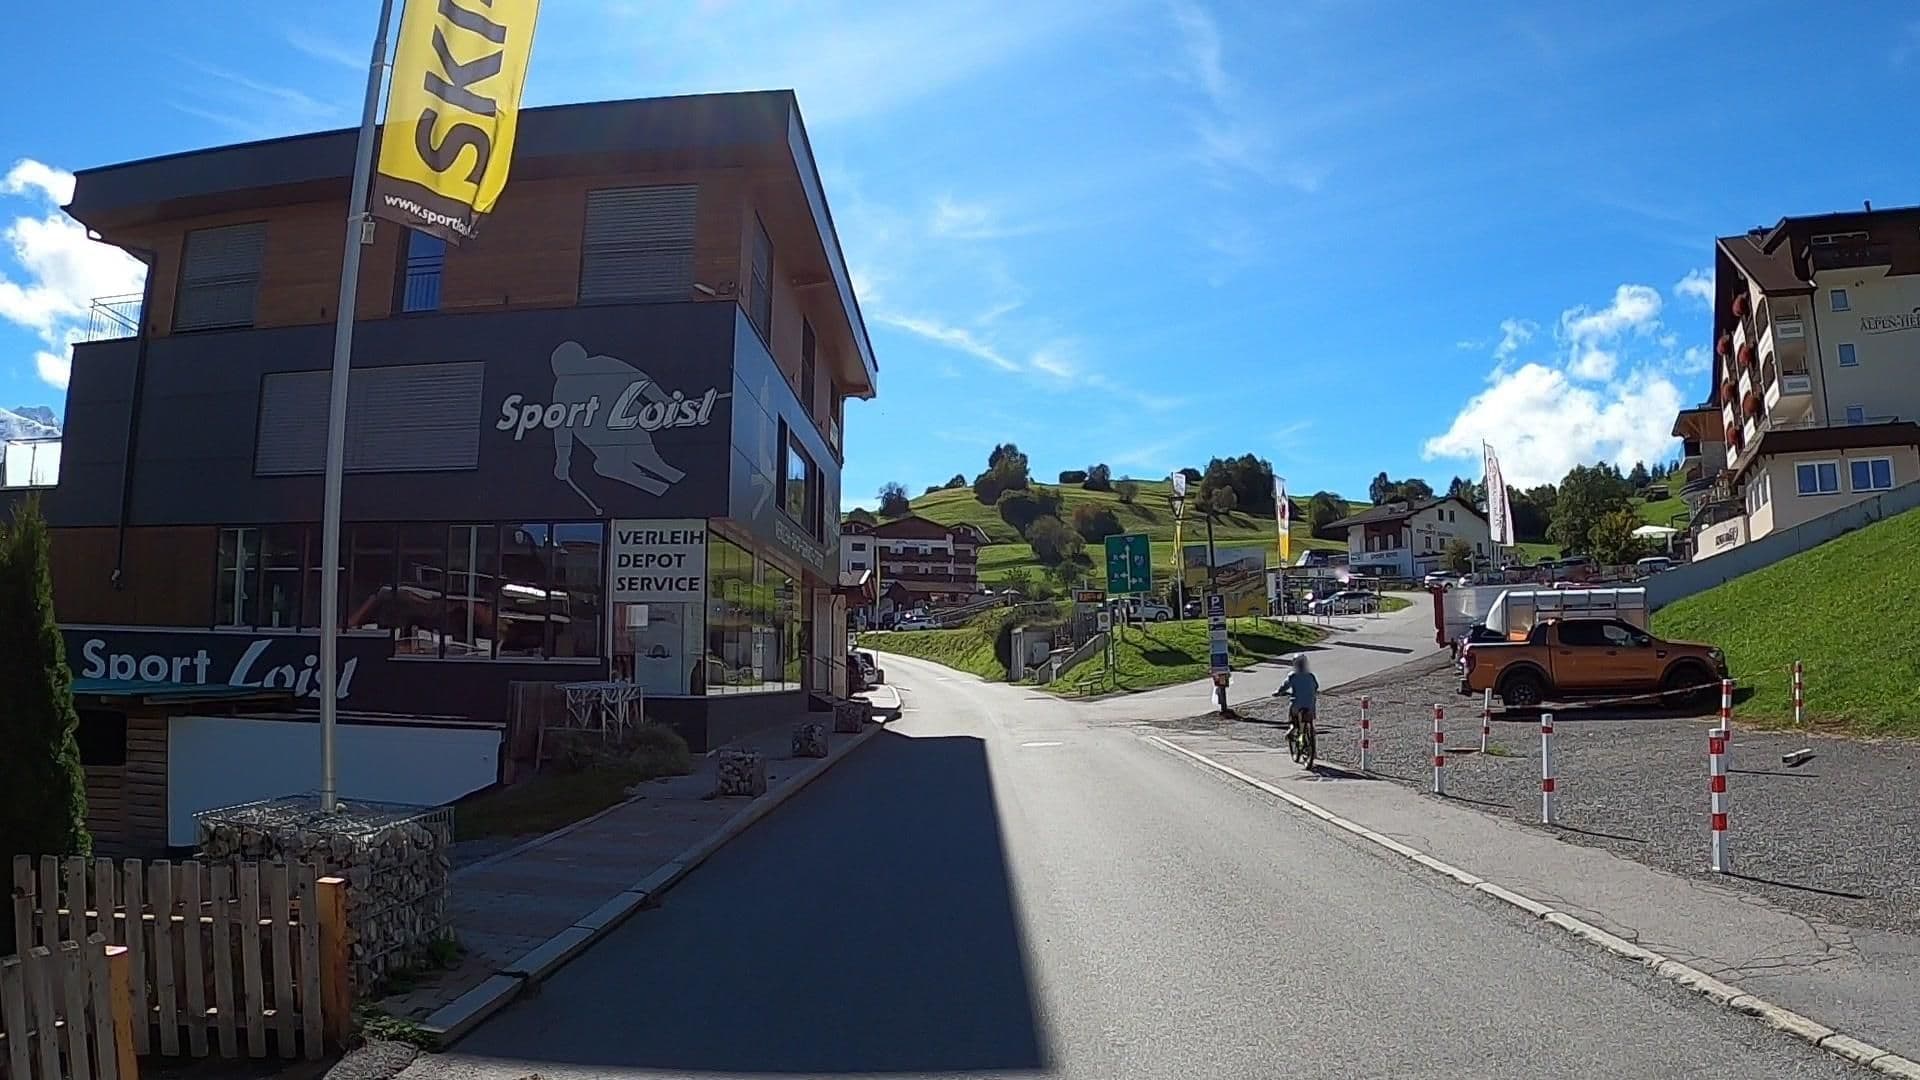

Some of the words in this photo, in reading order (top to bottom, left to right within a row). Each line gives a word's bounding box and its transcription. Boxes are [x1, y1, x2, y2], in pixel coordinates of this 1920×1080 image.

[415, 0, 508, 184] SKI
[496, 394, 600, 441] Sport
[607, 379, 718, 432] Loisl
[617, 530, 705, 545] VERLEIH
[617, 553, 687, 569] DEPOT
[616, 576, 700, 592] SERVICE
[82, 638, 211, 685] Sport
